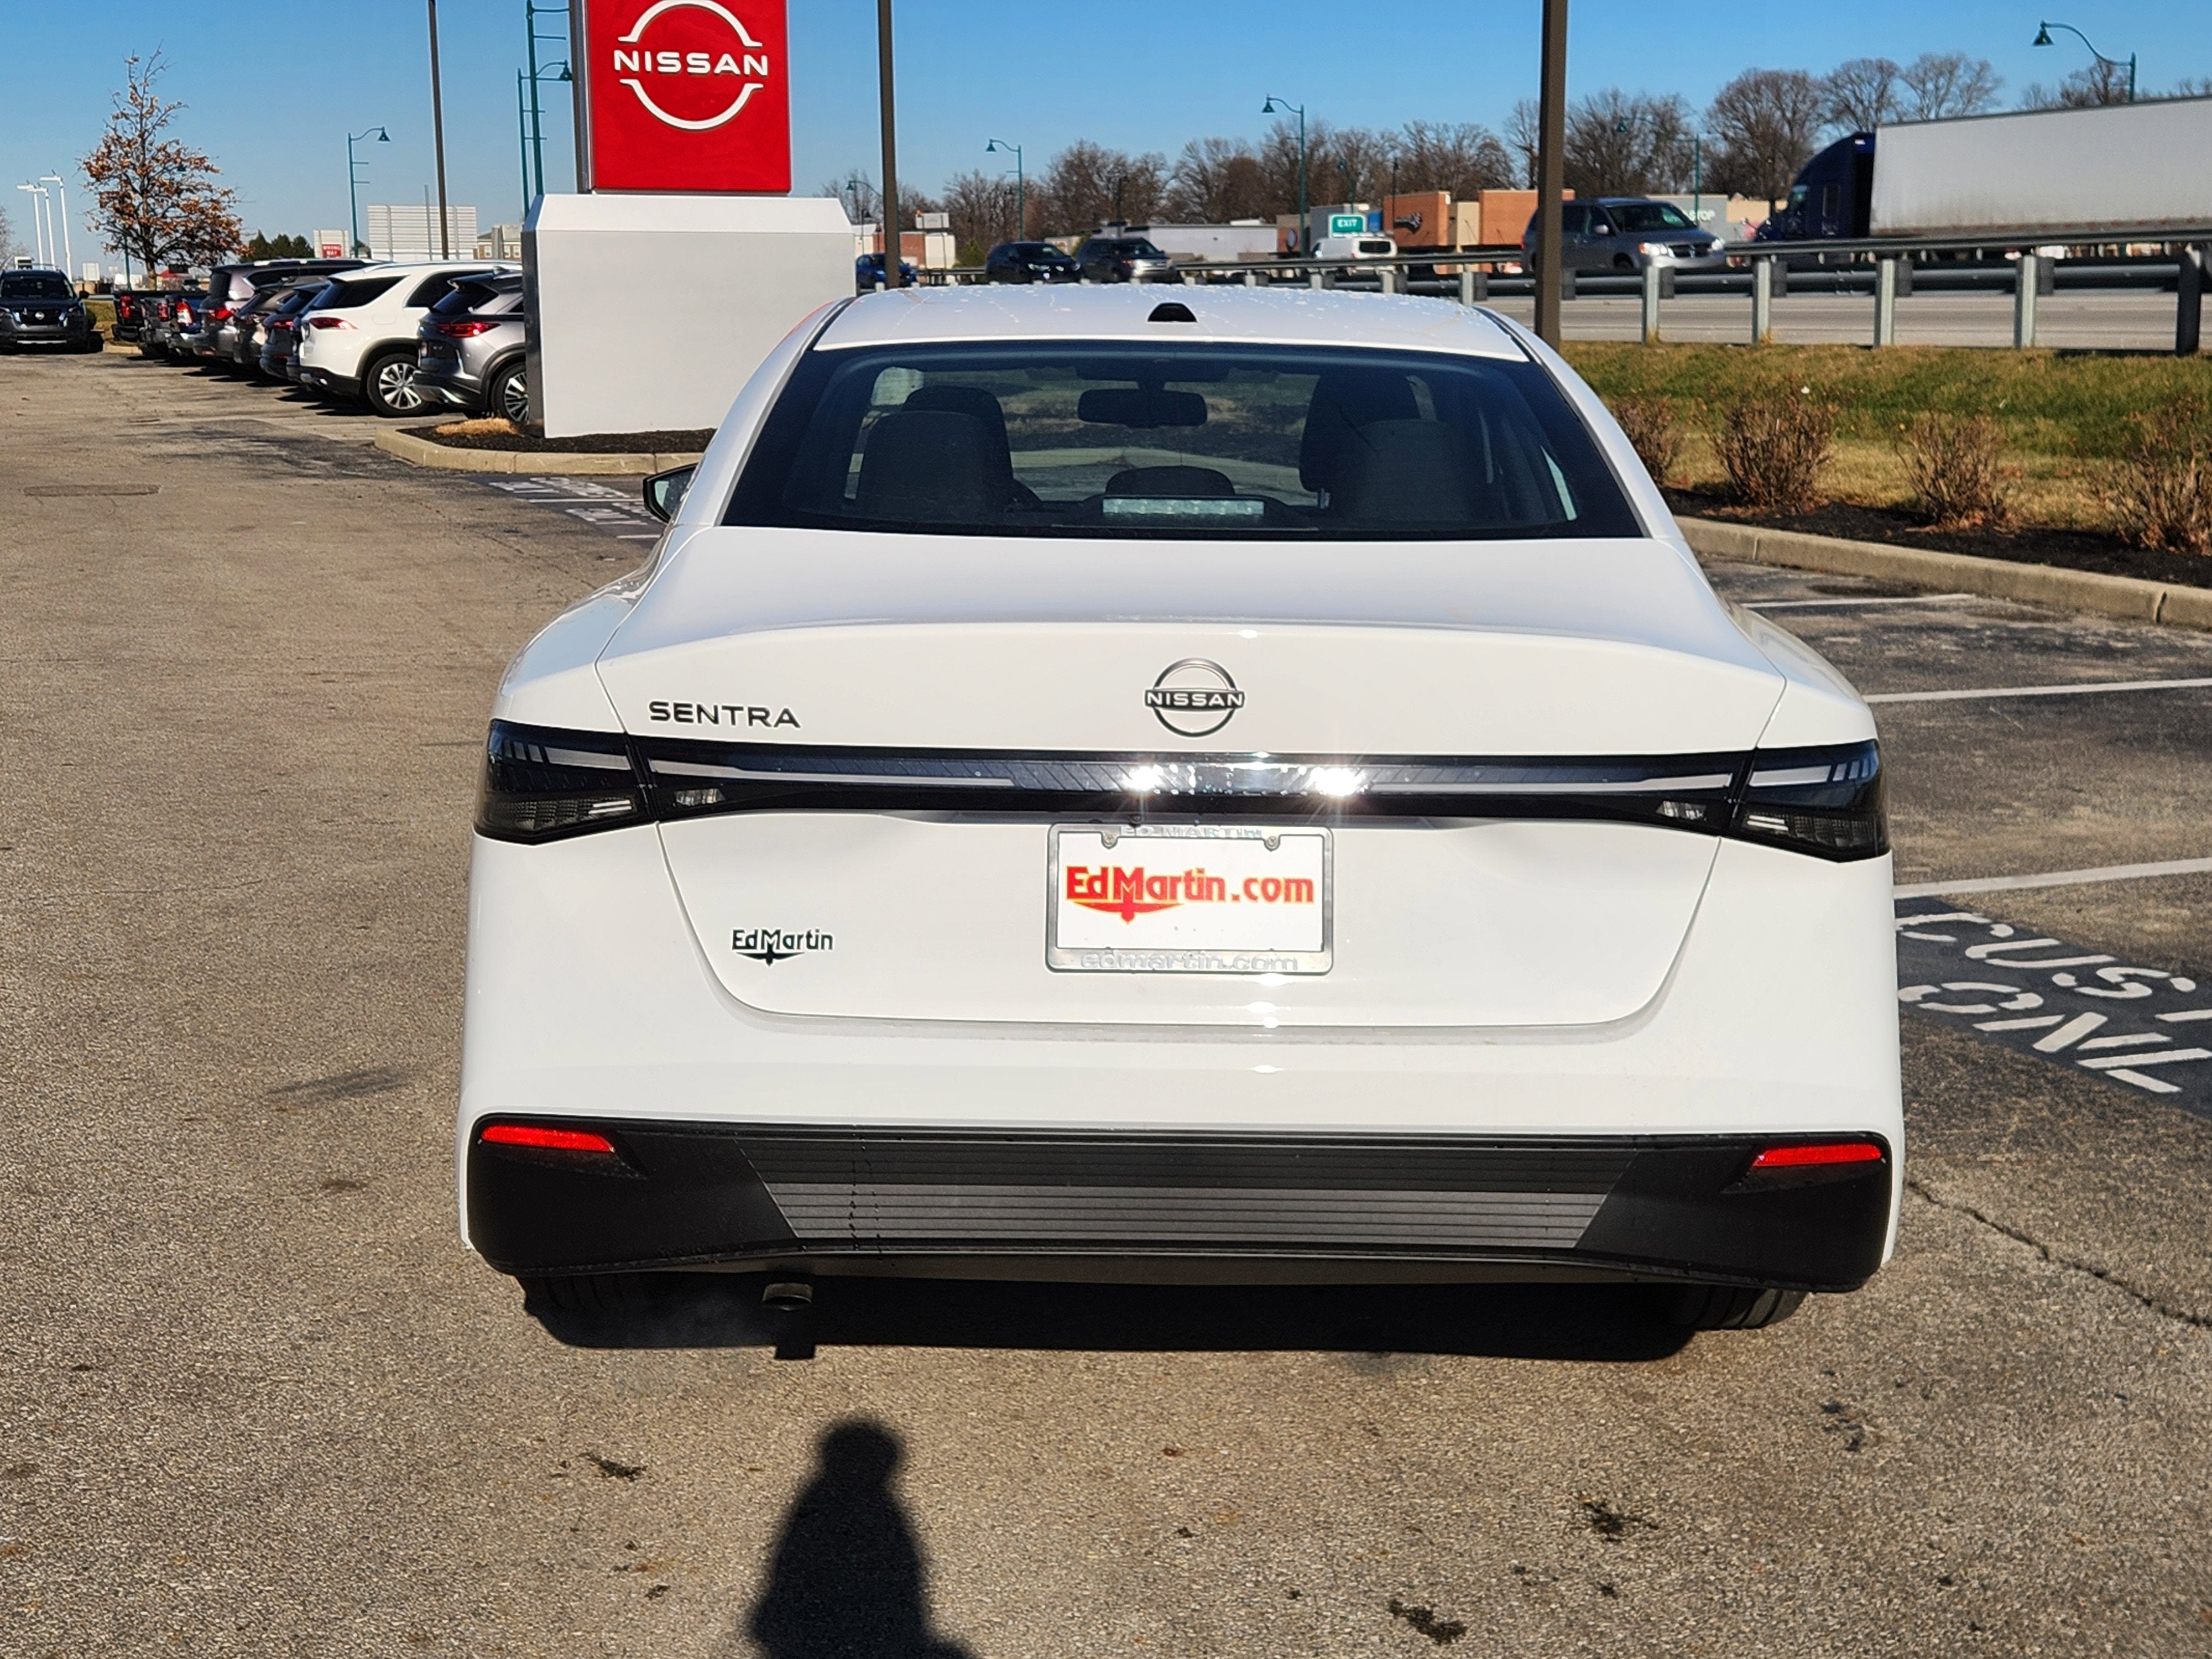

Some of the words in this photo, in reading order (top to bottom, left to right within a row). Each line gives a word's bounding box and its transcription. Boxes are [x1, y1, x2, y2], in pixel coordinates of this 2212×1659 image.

[613, 50, 768, 76] NISSAN
[1337, 219, 1358, 228] EXIT
[1147, 692, 1243, 707] NISSAN
[649, 701, 801, 728] SENTRA
[1066, 866, 1314, 903] EdMartin.com
[732, 928, 833, 950] EdMartin
[1081, 950, 1299, 971] edmartin.com
